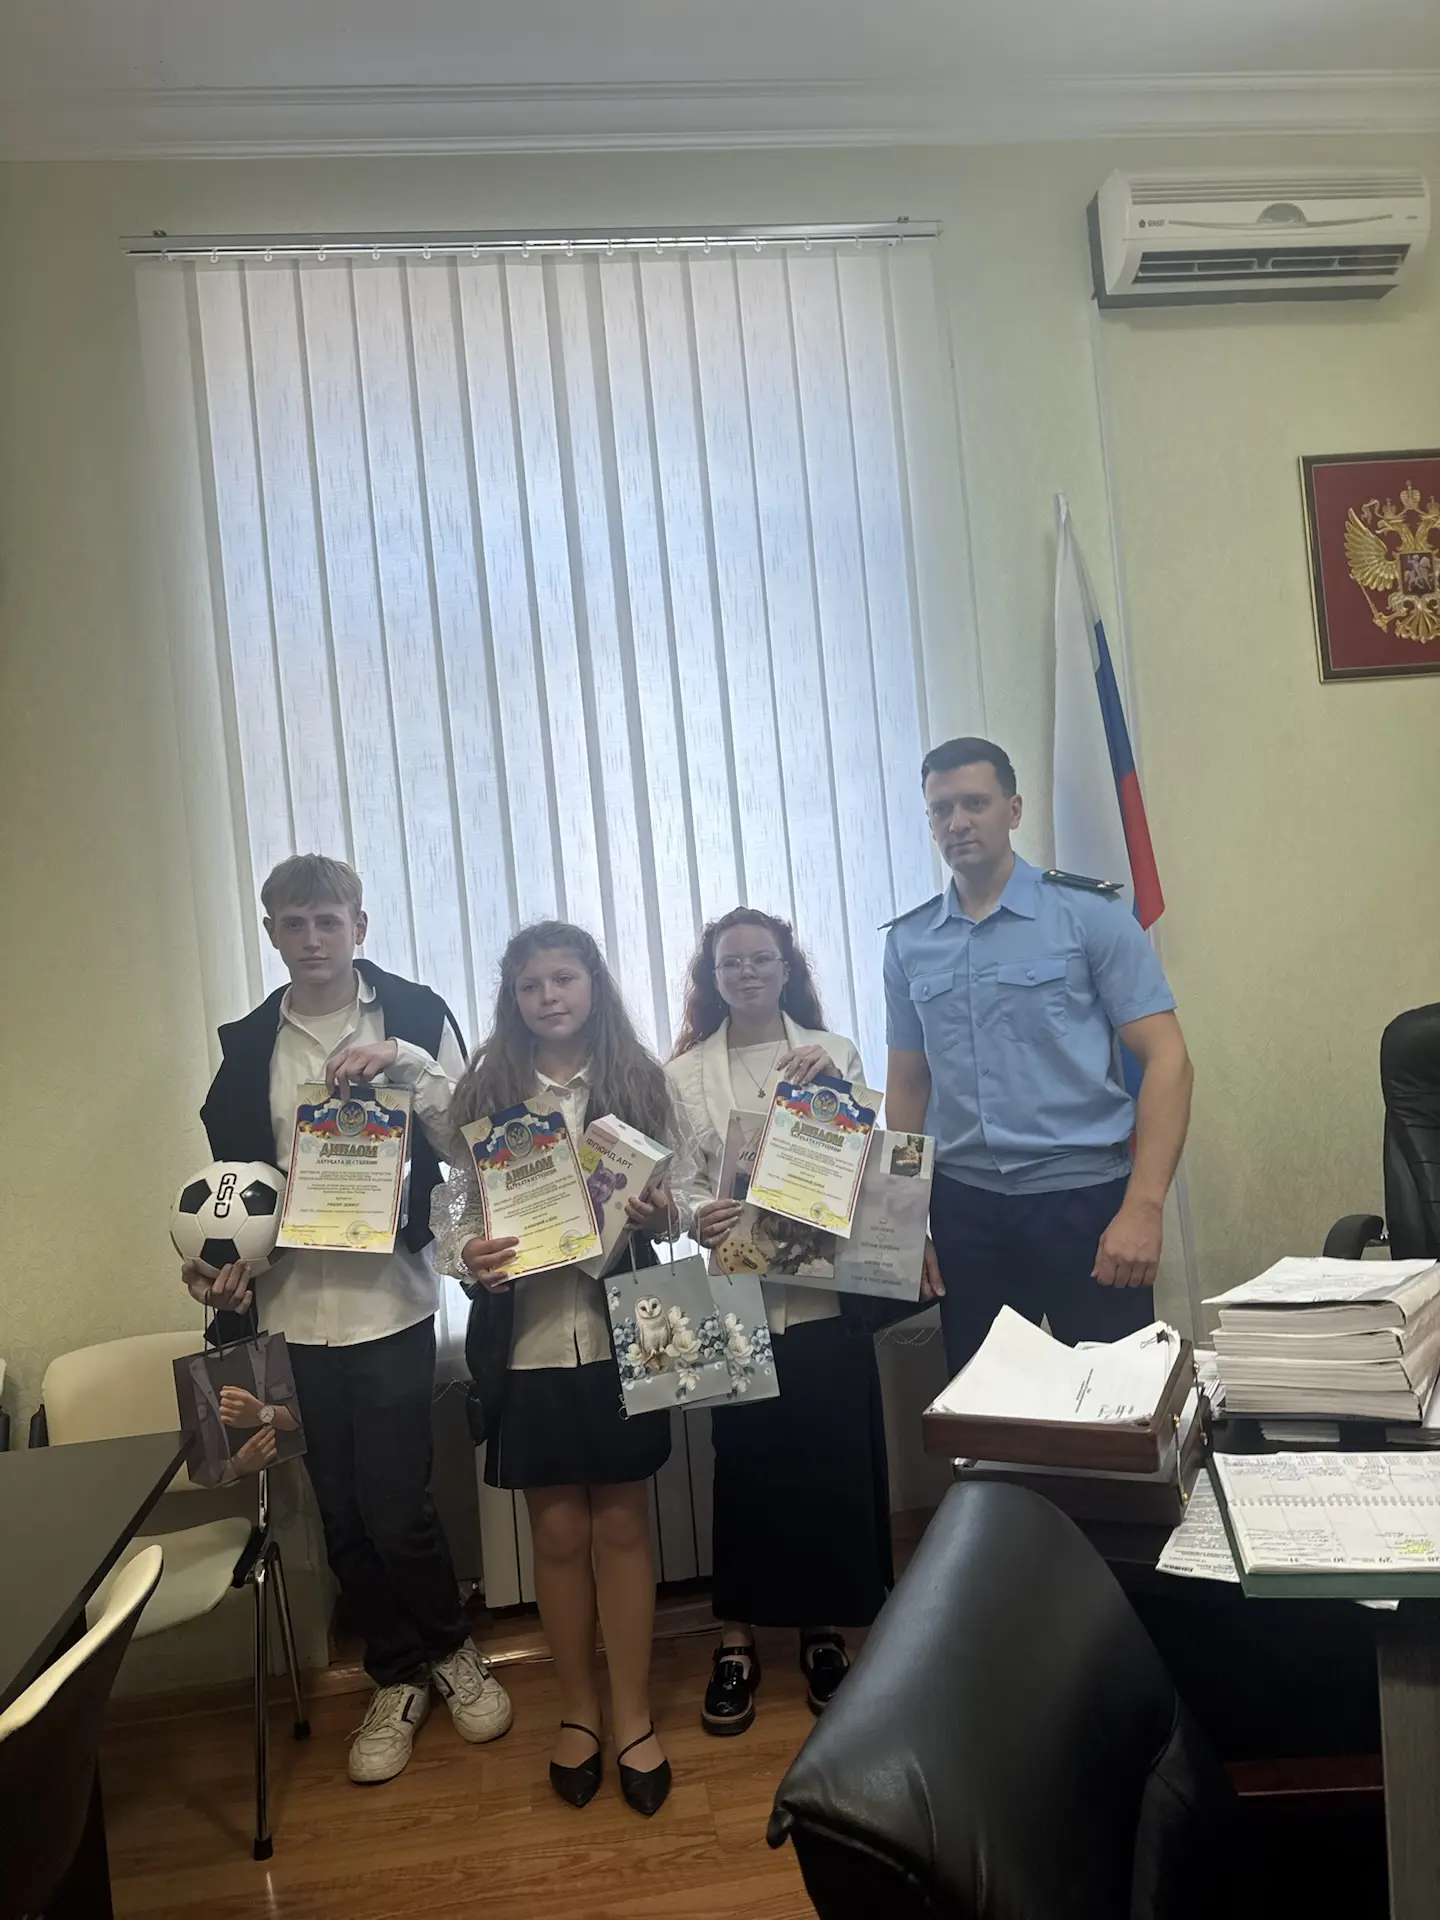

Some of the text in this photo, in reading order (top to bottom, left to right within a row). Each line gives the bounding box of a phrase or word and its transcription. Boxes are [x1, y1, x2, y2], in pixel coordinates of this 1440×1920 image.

[791, 1120, 845, 1147] ДИПЛОМ
[319, 1143, 378, 1158] ДИПЛОМ
[616, 1156, 633, 1170] АРТ
[505, 1155, 554, 1186] ДИПЛОМ
[213, 1173, 237, 1218] GSD
